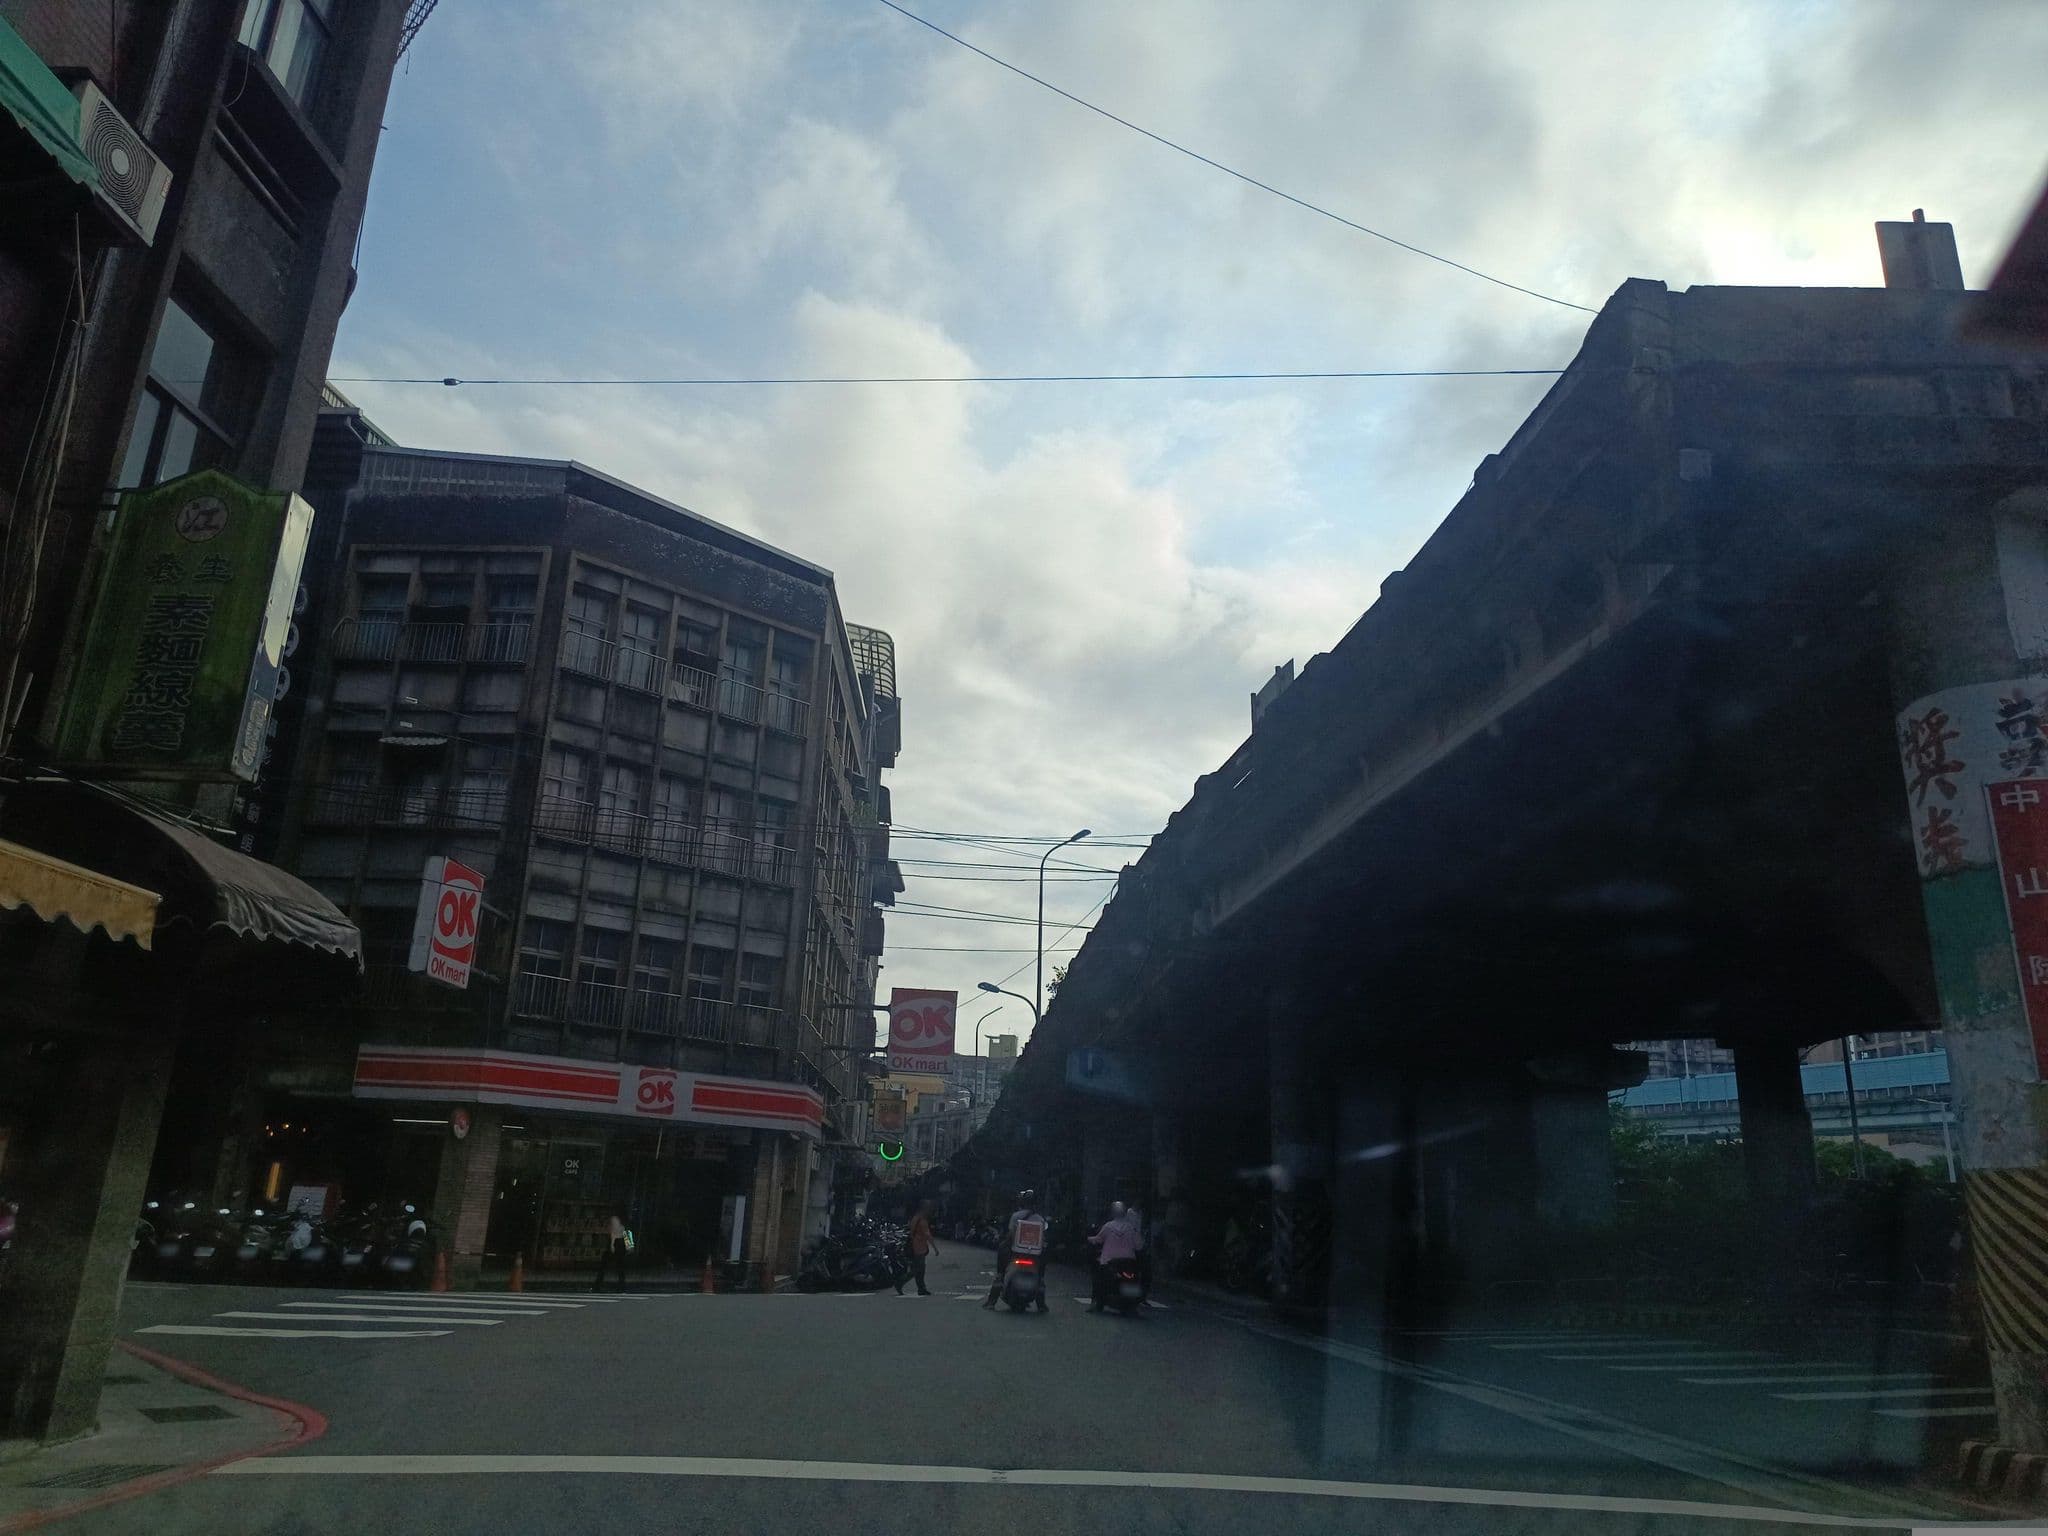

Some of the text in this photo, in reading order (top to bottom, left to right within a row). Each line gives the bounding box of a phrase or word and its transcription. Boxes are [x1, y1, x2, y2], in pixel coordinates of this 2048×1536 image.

[438, 890, 477, 938] OK
[432, 957, 466, 985] OK mart
[893, 1006, 952, 1041] OK
[892, 1057, 949, 1071] OK mart
[638, 1081, 674, 1104] OK
[564, 1159, 580, 1168] OK
